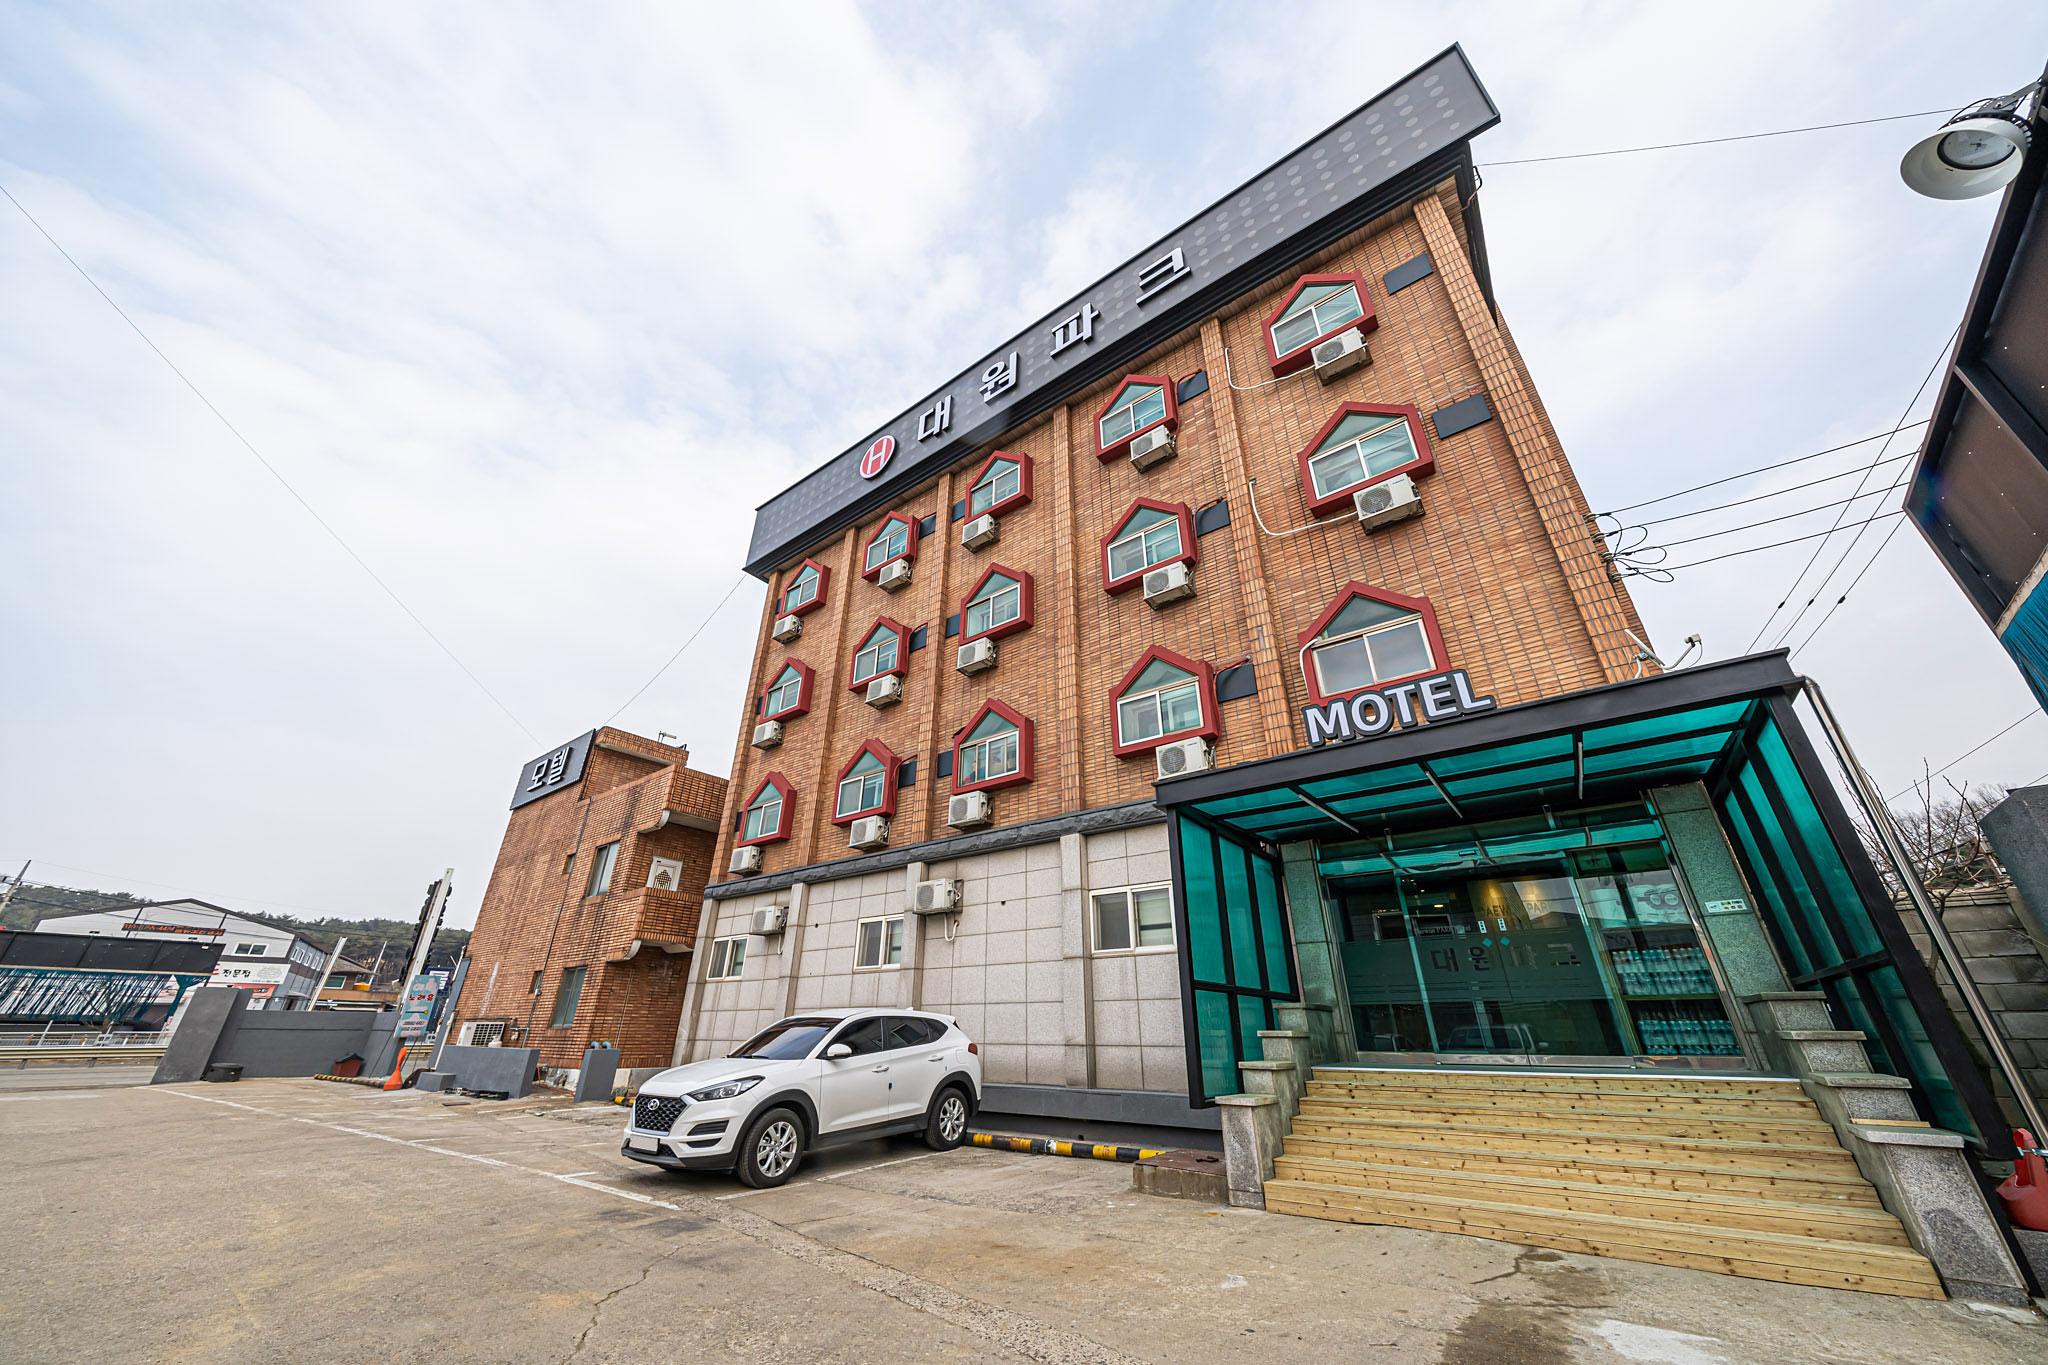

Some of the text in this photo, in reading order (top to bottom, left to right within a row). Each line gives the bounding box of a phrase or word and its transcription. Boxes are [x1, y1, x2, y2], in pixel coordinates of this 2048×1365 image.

[917, 247, 1192, 442] 대원파크
[1304, 671, 1493, 745] MOTEL
[526, 746, 571, 792] 모텔
